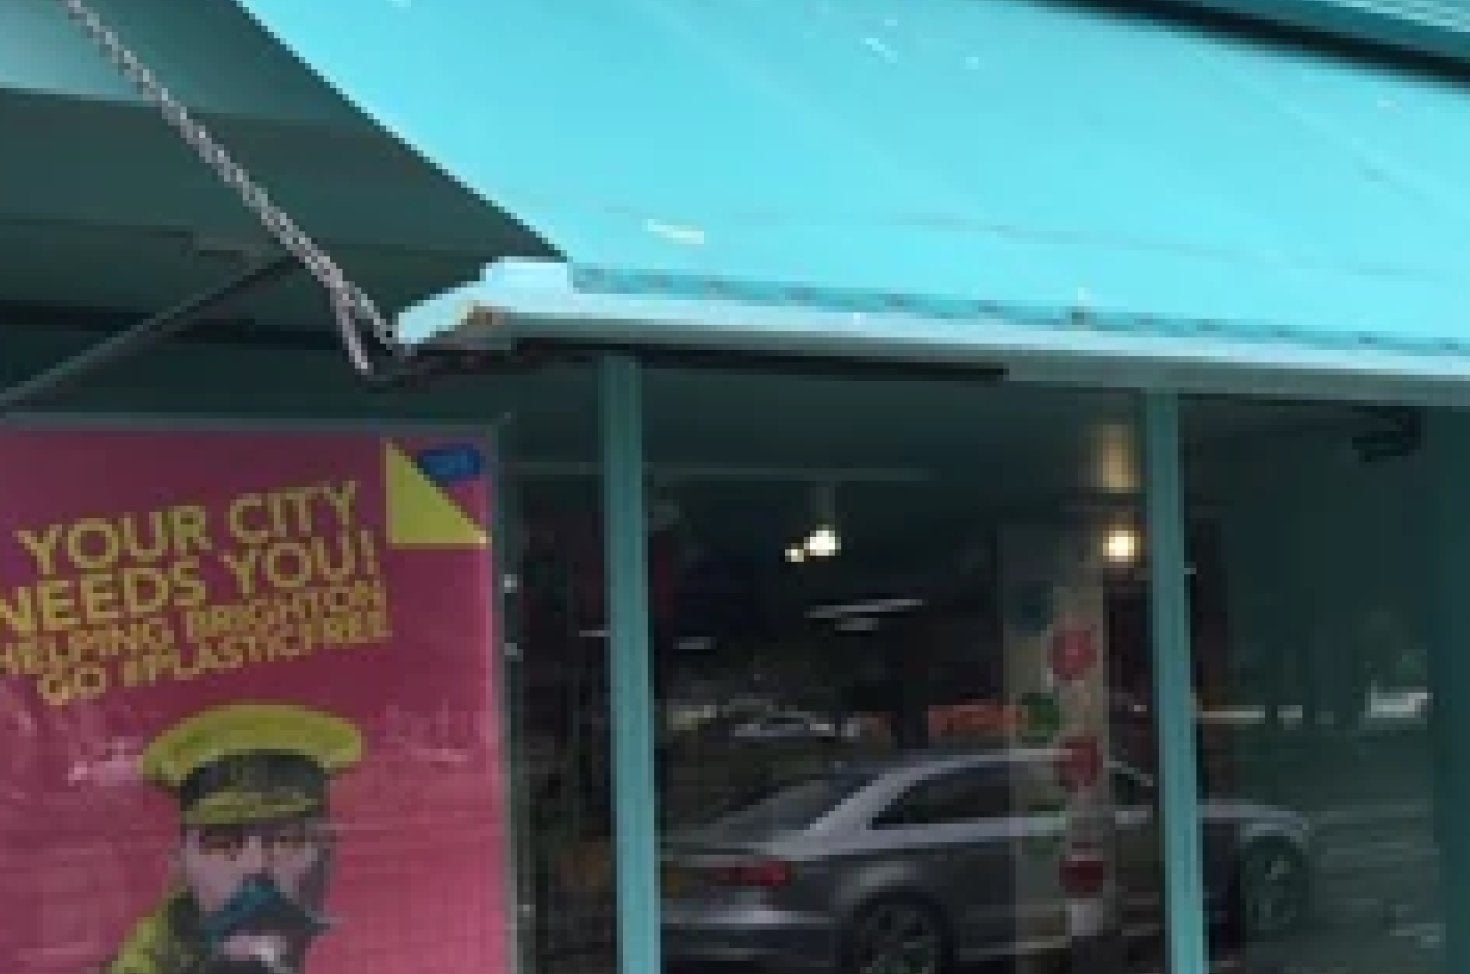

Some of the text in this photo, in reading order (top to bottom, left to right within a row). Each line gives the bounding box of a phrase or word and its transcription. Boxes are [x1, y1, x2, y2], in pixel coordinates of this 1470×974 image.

[16, 480, 360, 575] YOUR CITY
[0, 530, 378, 632] NEEDS YOU!
[187, 579, 386, 640] BRIGHTON
[37, 667, 106, 705] GO
